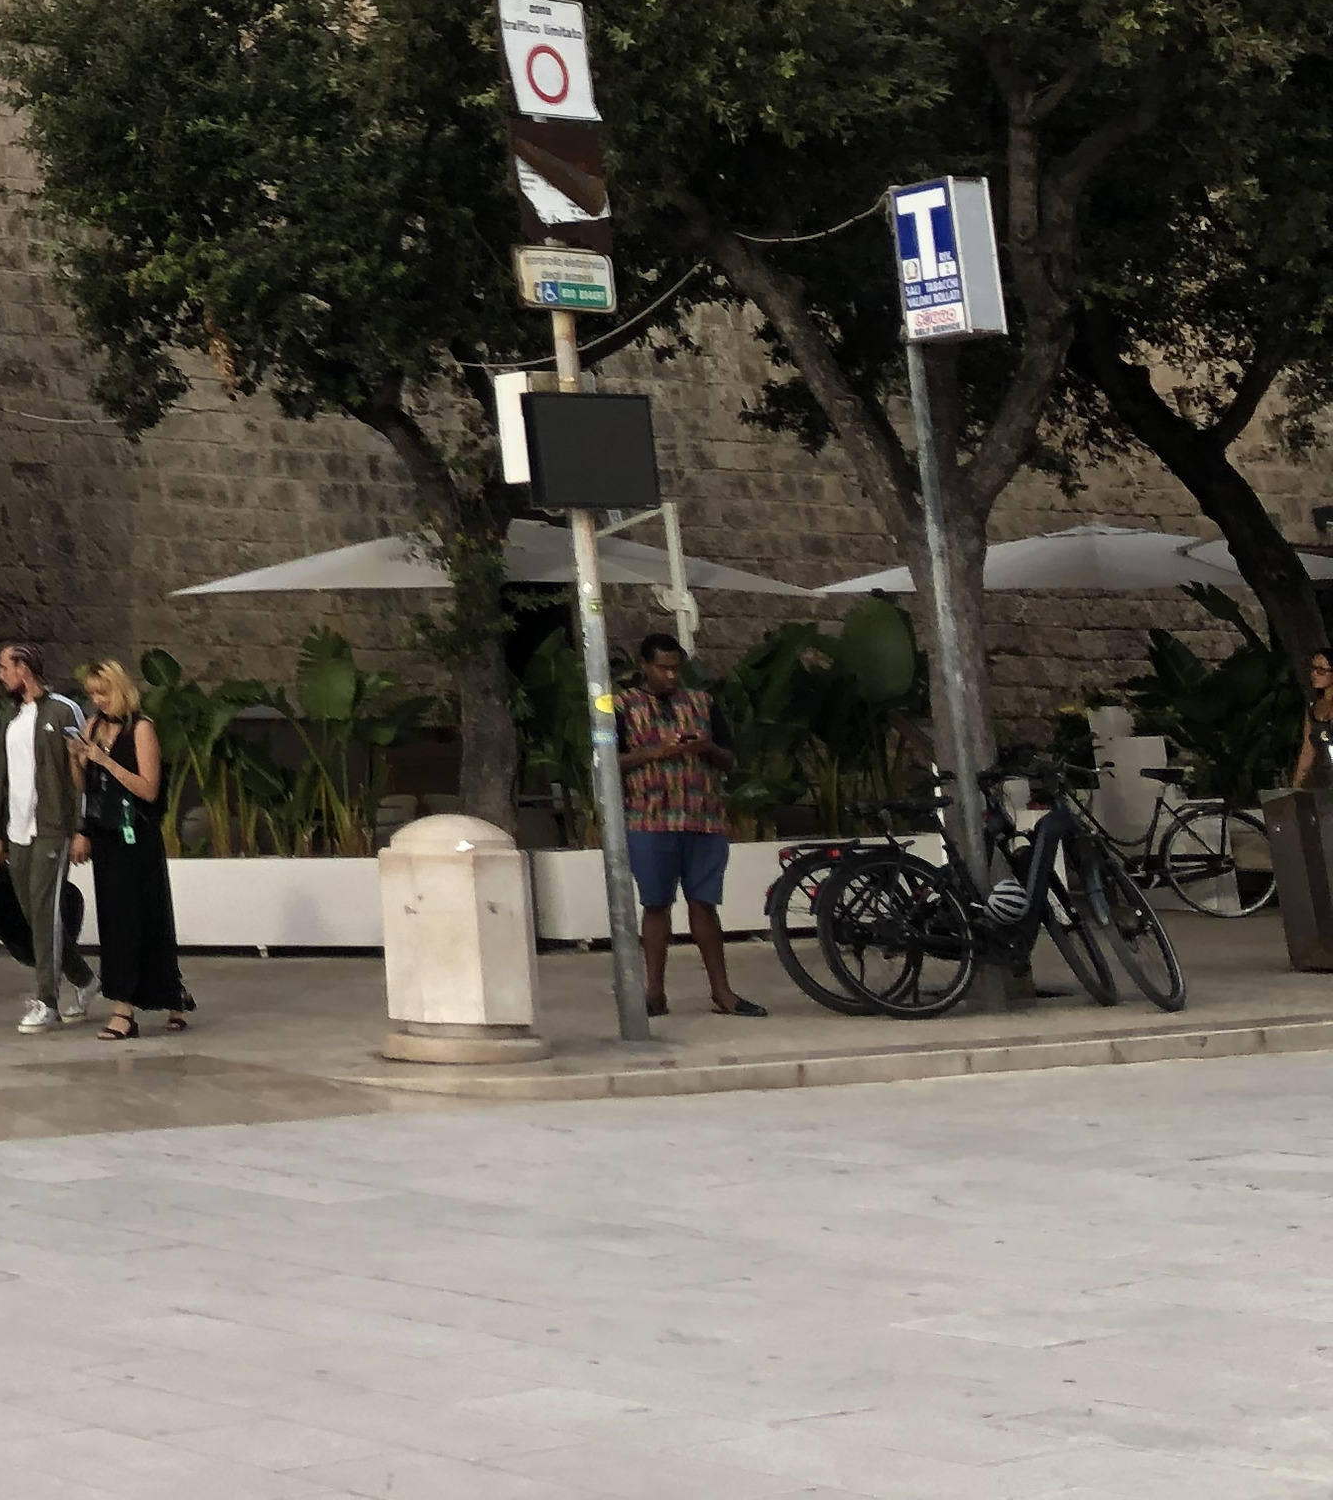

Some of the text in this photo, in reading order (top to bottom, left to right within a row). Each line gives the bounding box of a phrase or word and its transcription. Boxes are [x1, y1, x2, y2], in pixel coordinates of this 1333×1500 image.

[502, 18, 583, 39] traffico limitato
[896, 187, 946, 280] T
